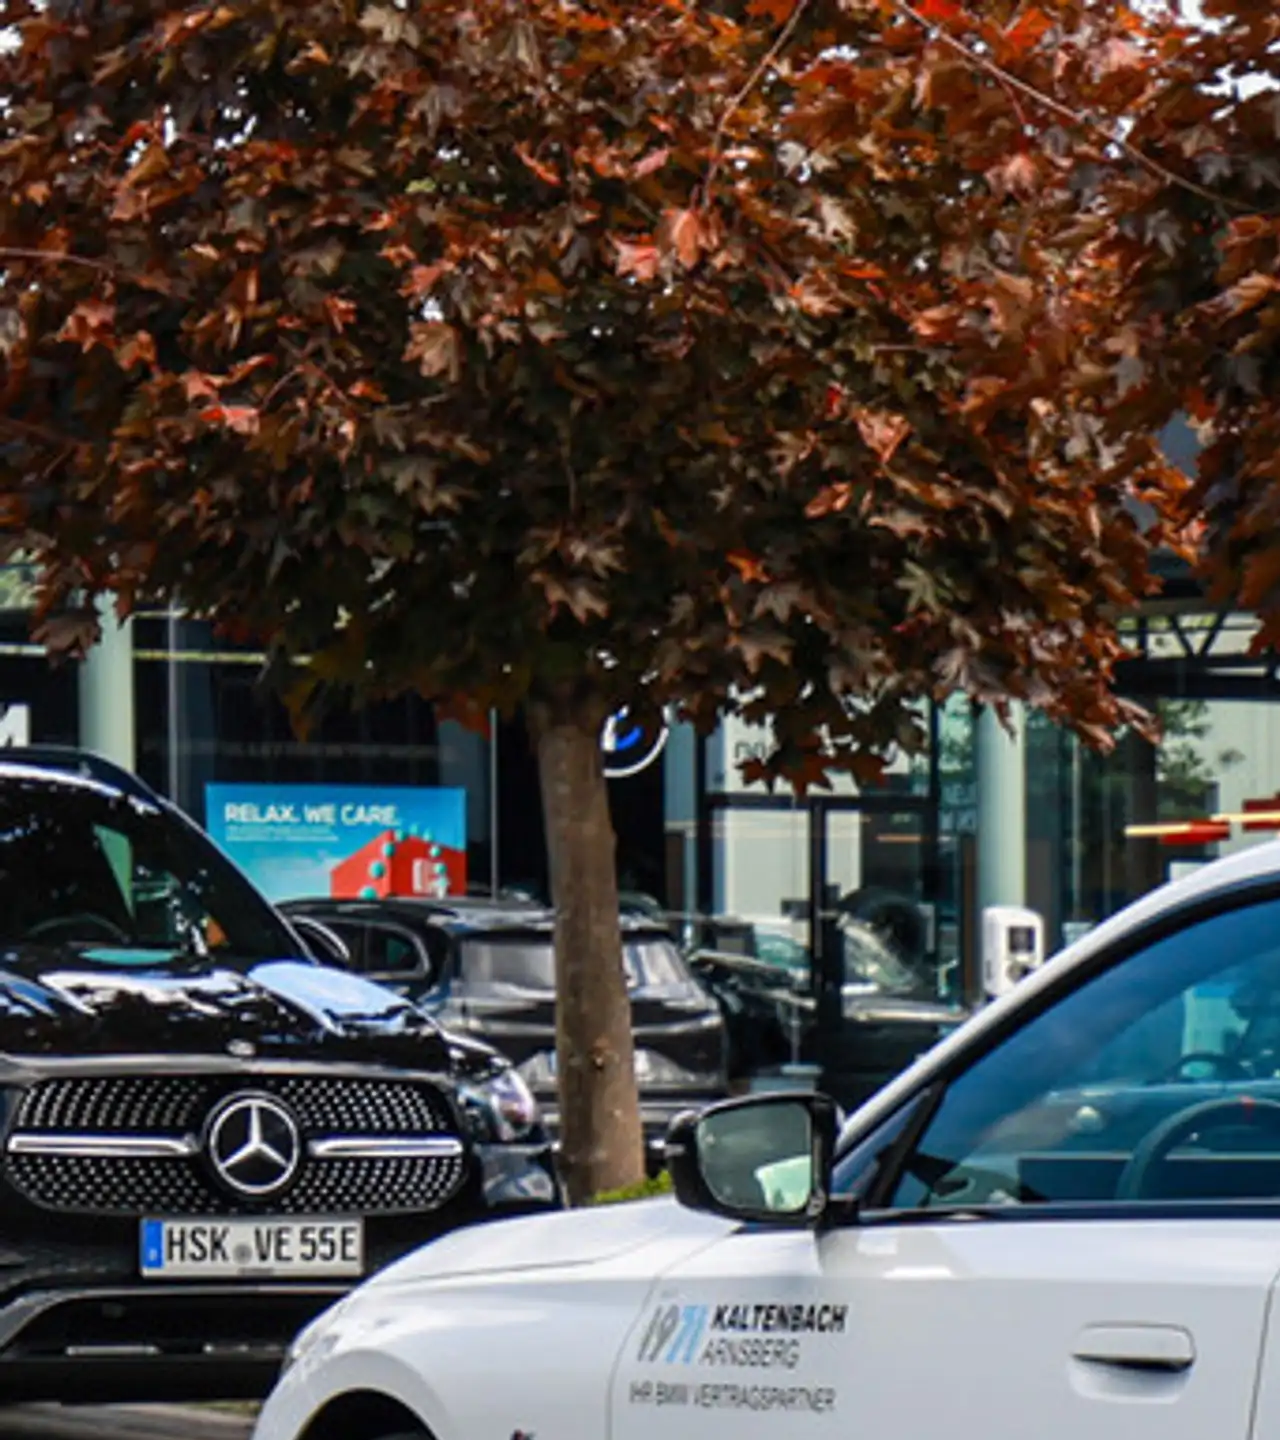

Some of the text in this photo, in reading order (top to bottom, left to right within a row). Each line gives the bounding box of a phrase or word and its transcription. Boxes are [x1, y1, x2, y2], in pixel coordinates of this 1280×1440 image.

[224, 803, 299, 823] RELAX.
[303, 805, 336, 824] WE
[166, 1226, 358, 1262] HSK VE 55E
[710, 1304, 848, 1333] KALTENBACH
[698, 1337, 801, 1369] ARNSBERG
